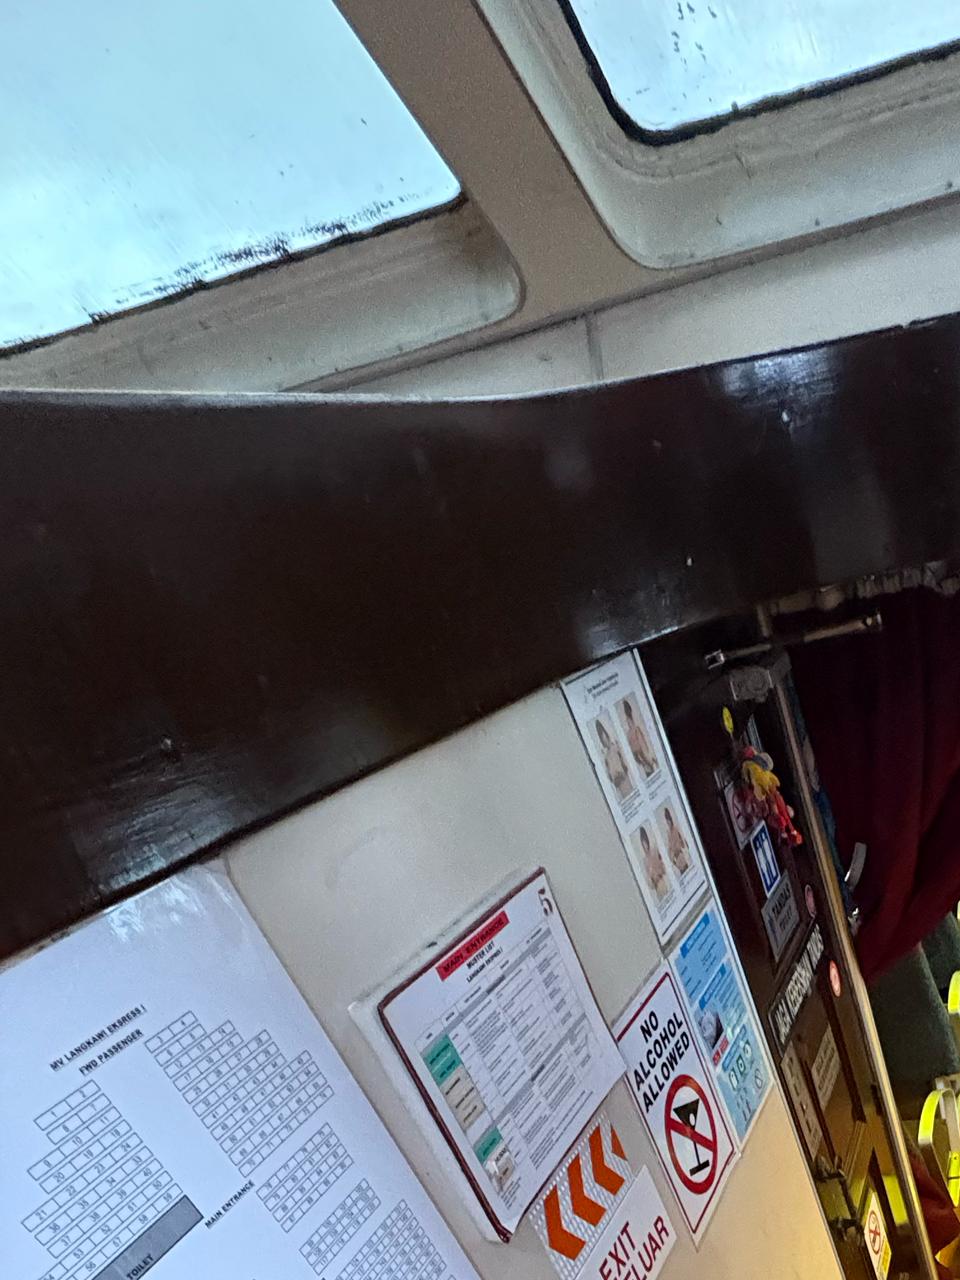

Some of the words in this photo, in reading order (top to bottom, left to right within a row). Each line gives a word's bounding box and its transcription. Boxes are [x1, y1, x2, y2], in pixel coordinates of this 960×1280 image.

[538, 887, 554, 917] 5
[443, 953, 464, 972] MAIN
[465, 919, 505, 954] ENTRANCE
[785, 948, 814, 1017] KEBERSIHAN
[50, 1057, 64, 1072] MV
[64, 1029, 108, 1061] LANGKAWI
[640, 1011, 659, 1043] NO
[79, 1059, 98, 1075] FWD
[98, 1029, 143, 1062] PASSENGER
[633, 1013, 683, 1091] ALCOHOL
[642, 1031, 690, 1113] ALLOWED
[205, 1210, 223, 1229] MAIN
[222, 1180, 255, 1212] ENTRANCE
[126, 1253, 155, 1280] TOILET
